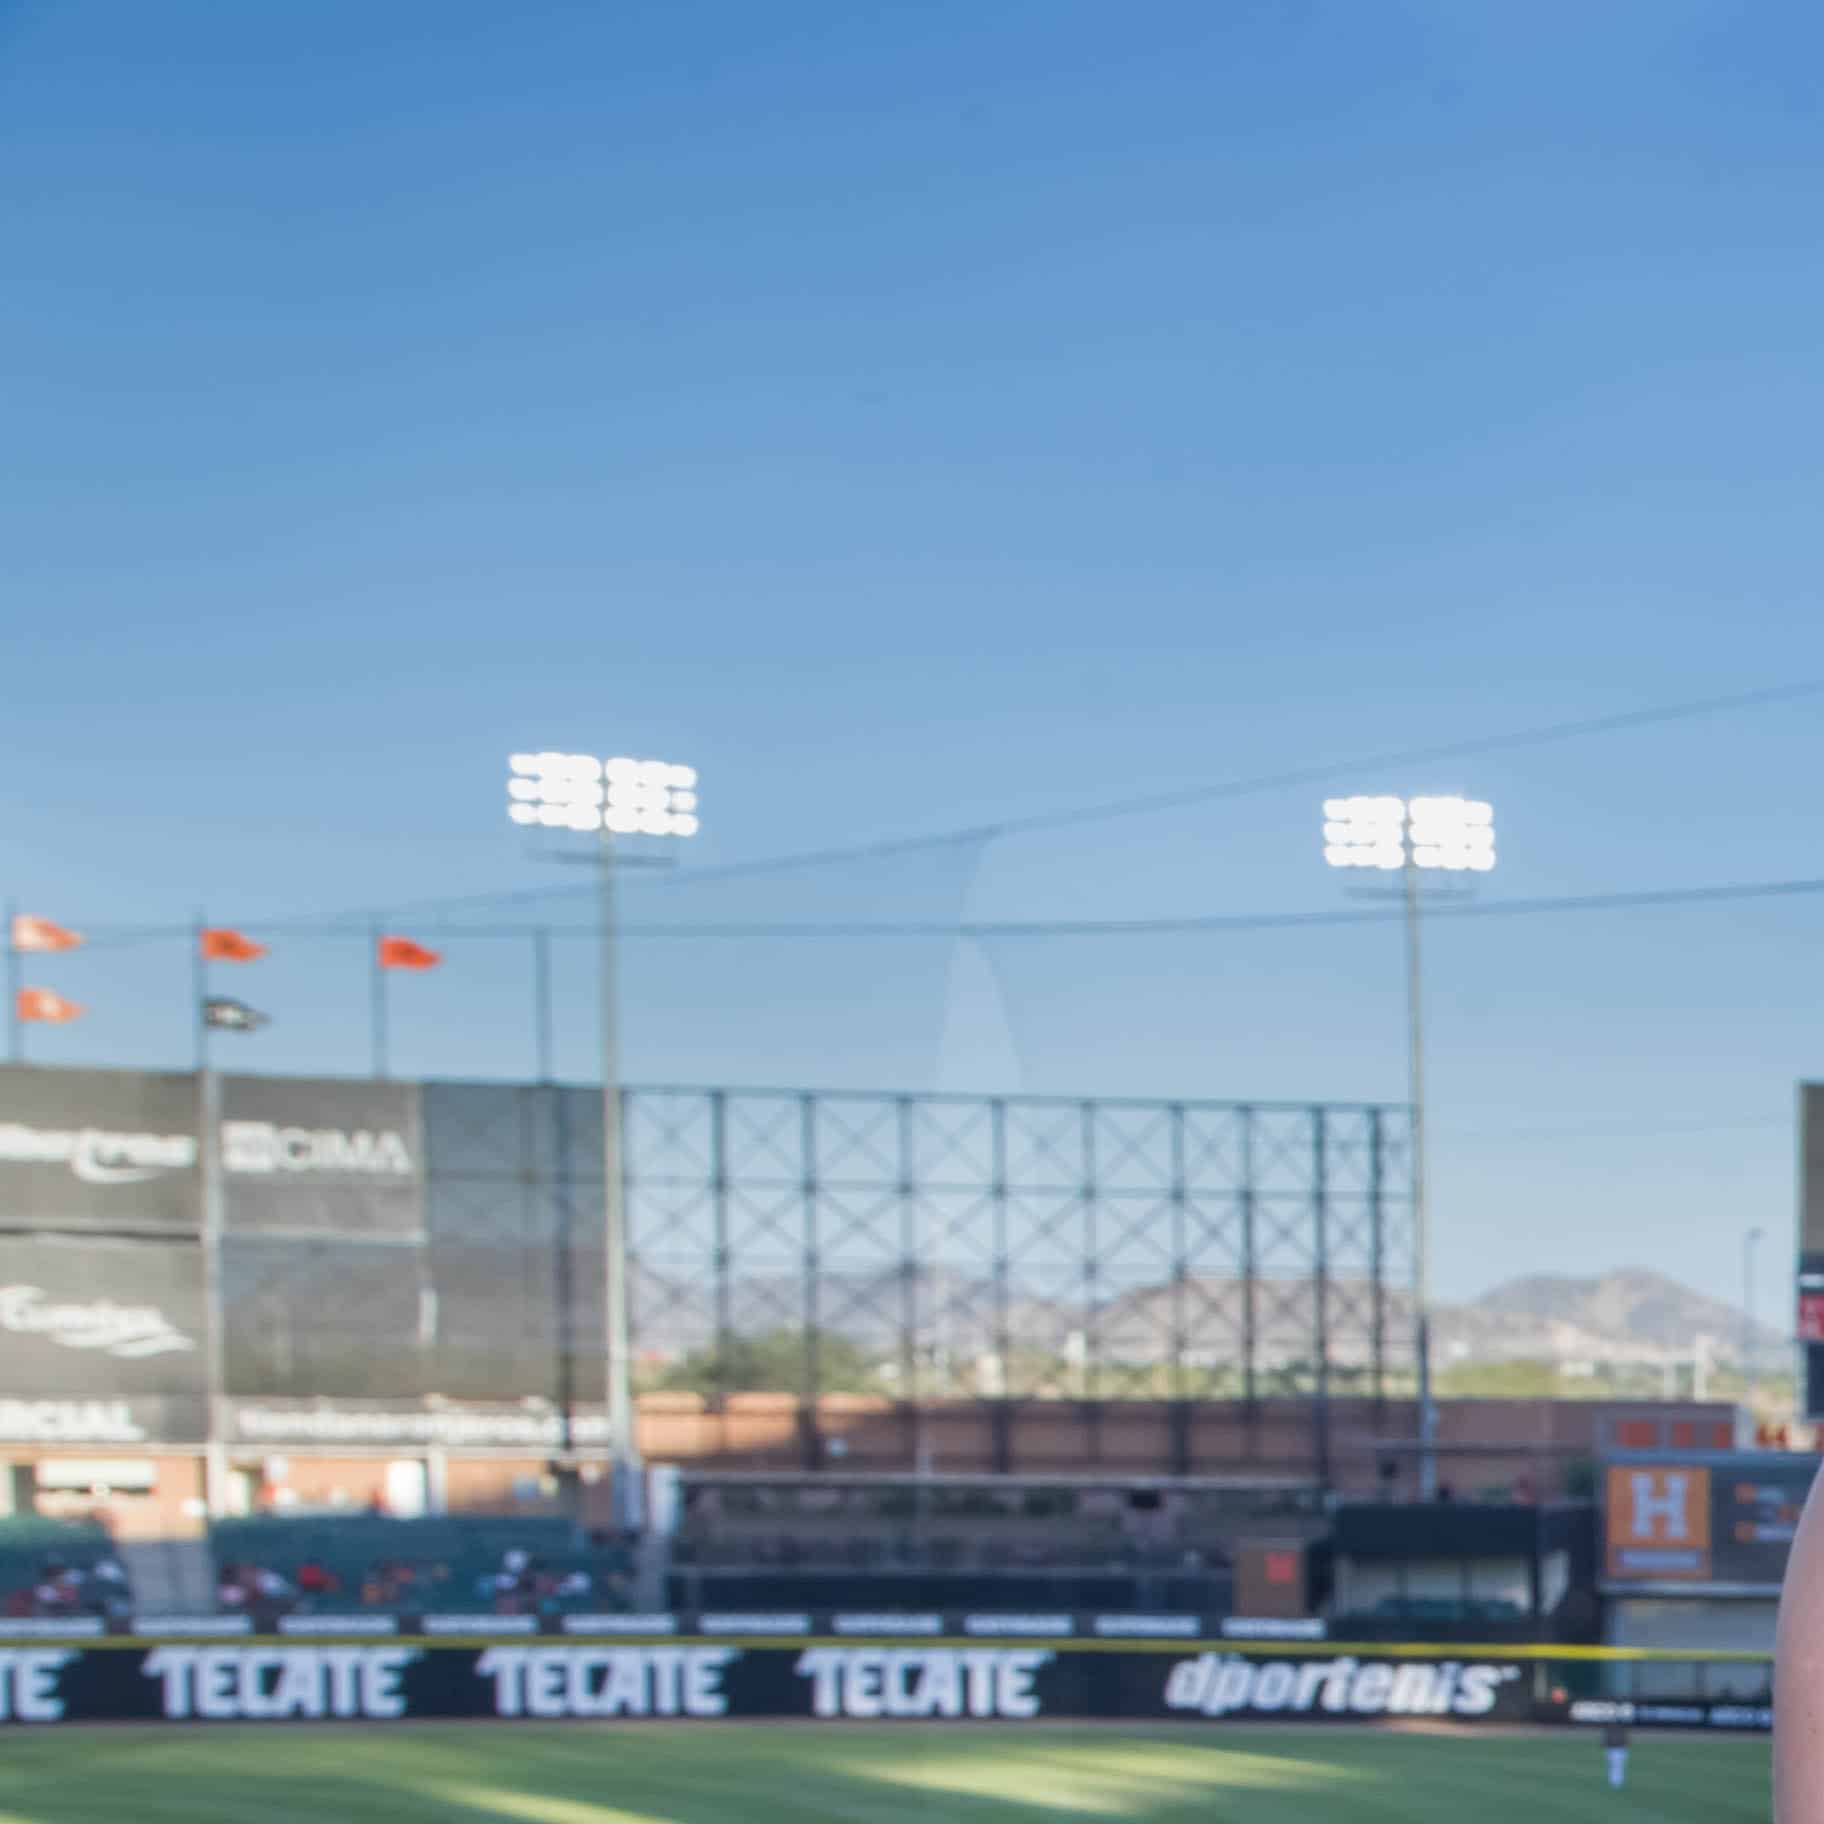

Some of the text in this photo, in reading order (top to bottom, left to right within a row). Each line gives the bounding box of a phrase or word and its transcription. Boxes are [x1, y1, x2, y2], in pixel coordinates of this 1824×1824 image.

[279, 1127, 413, 1176] CIMA
[1631, 1471, 1689, 1540] H
[141, 1646, 422, 1719] TECATE
[475, 1646, 744, 1718] TECATE
[795, 1647, 1056, 1718] TECATE
[1164, 1651, 1500, 1717] dportenis
